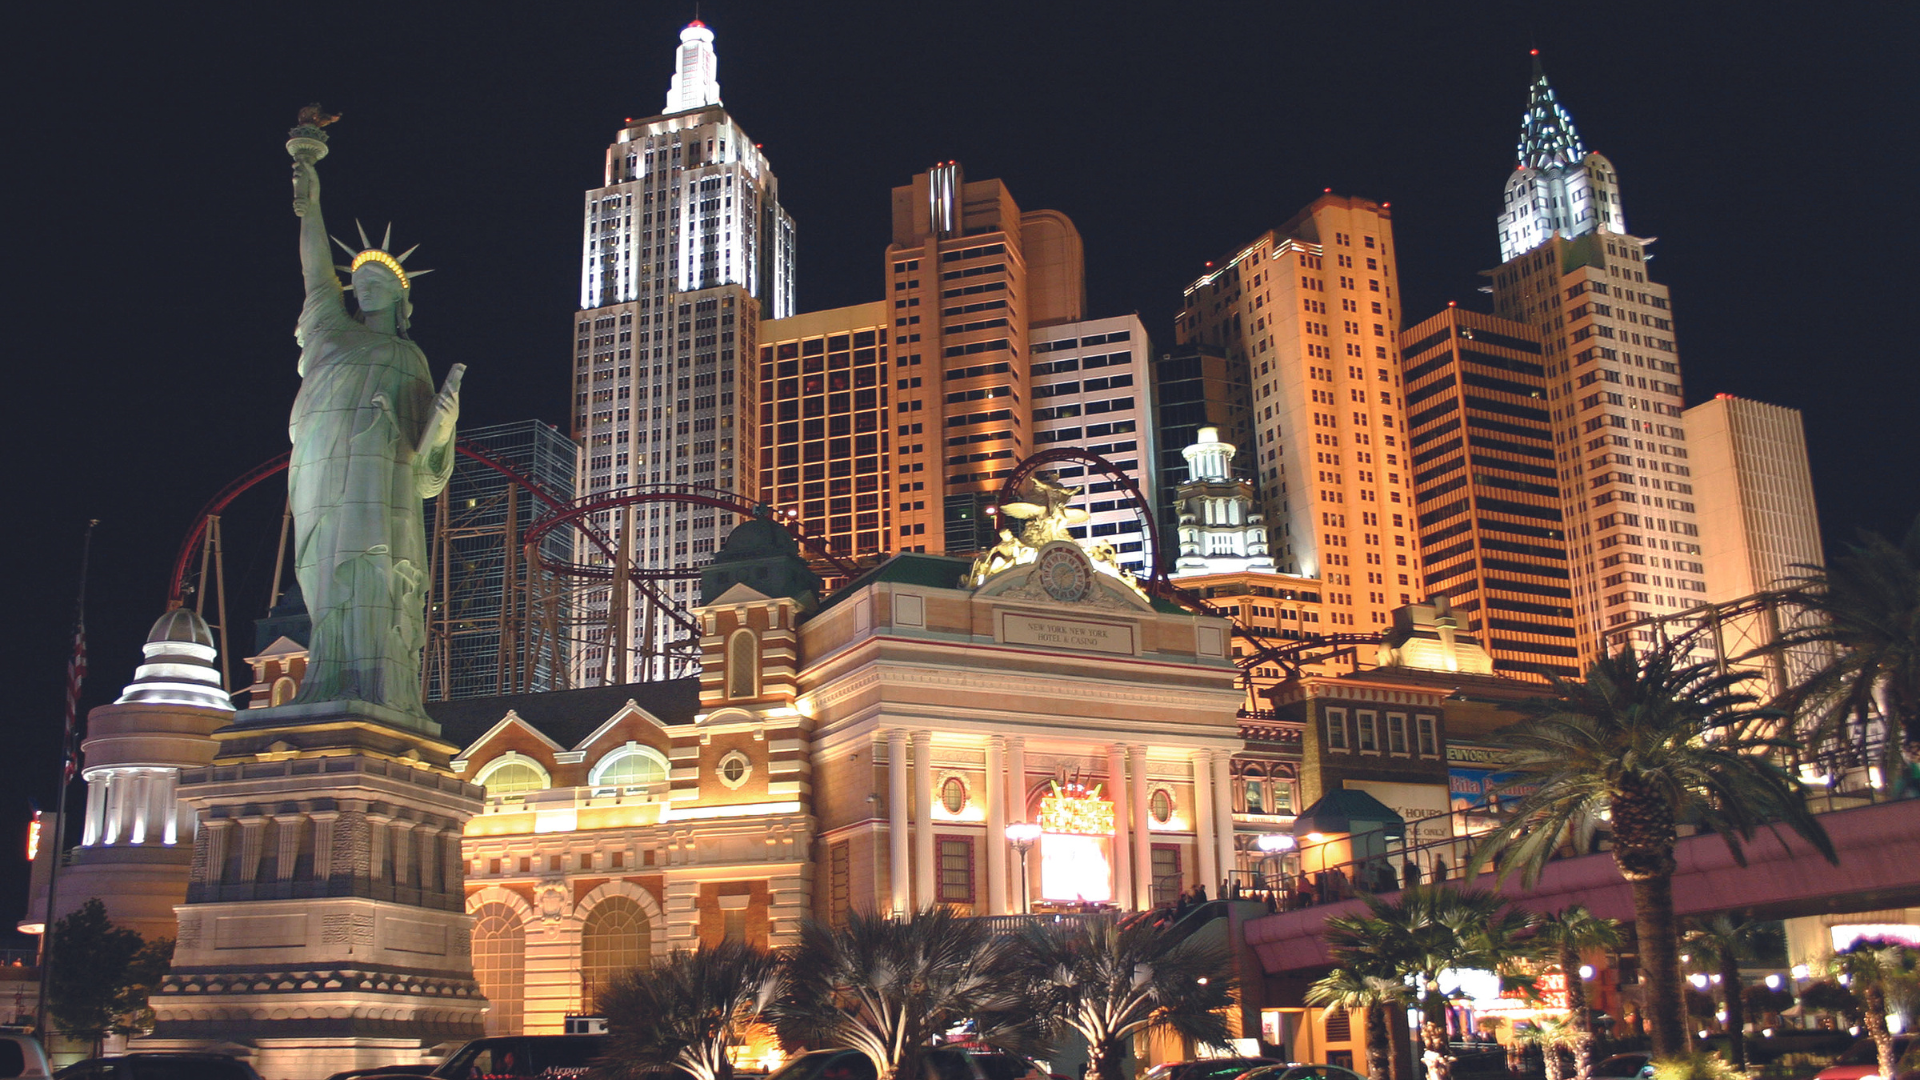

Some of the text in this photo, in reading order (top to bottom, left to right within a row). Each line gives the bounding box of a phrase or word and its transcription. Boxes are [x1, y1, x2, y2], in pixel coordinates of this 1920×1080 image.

[1027, 622, 1108, 638] NEW YORK NEW YORK
[1038, 633, 1098, 646] HOTEL & CASINO
[1450, 776, 1480, 794] Rita
[1423, 828, 1446, 837] ONLY
